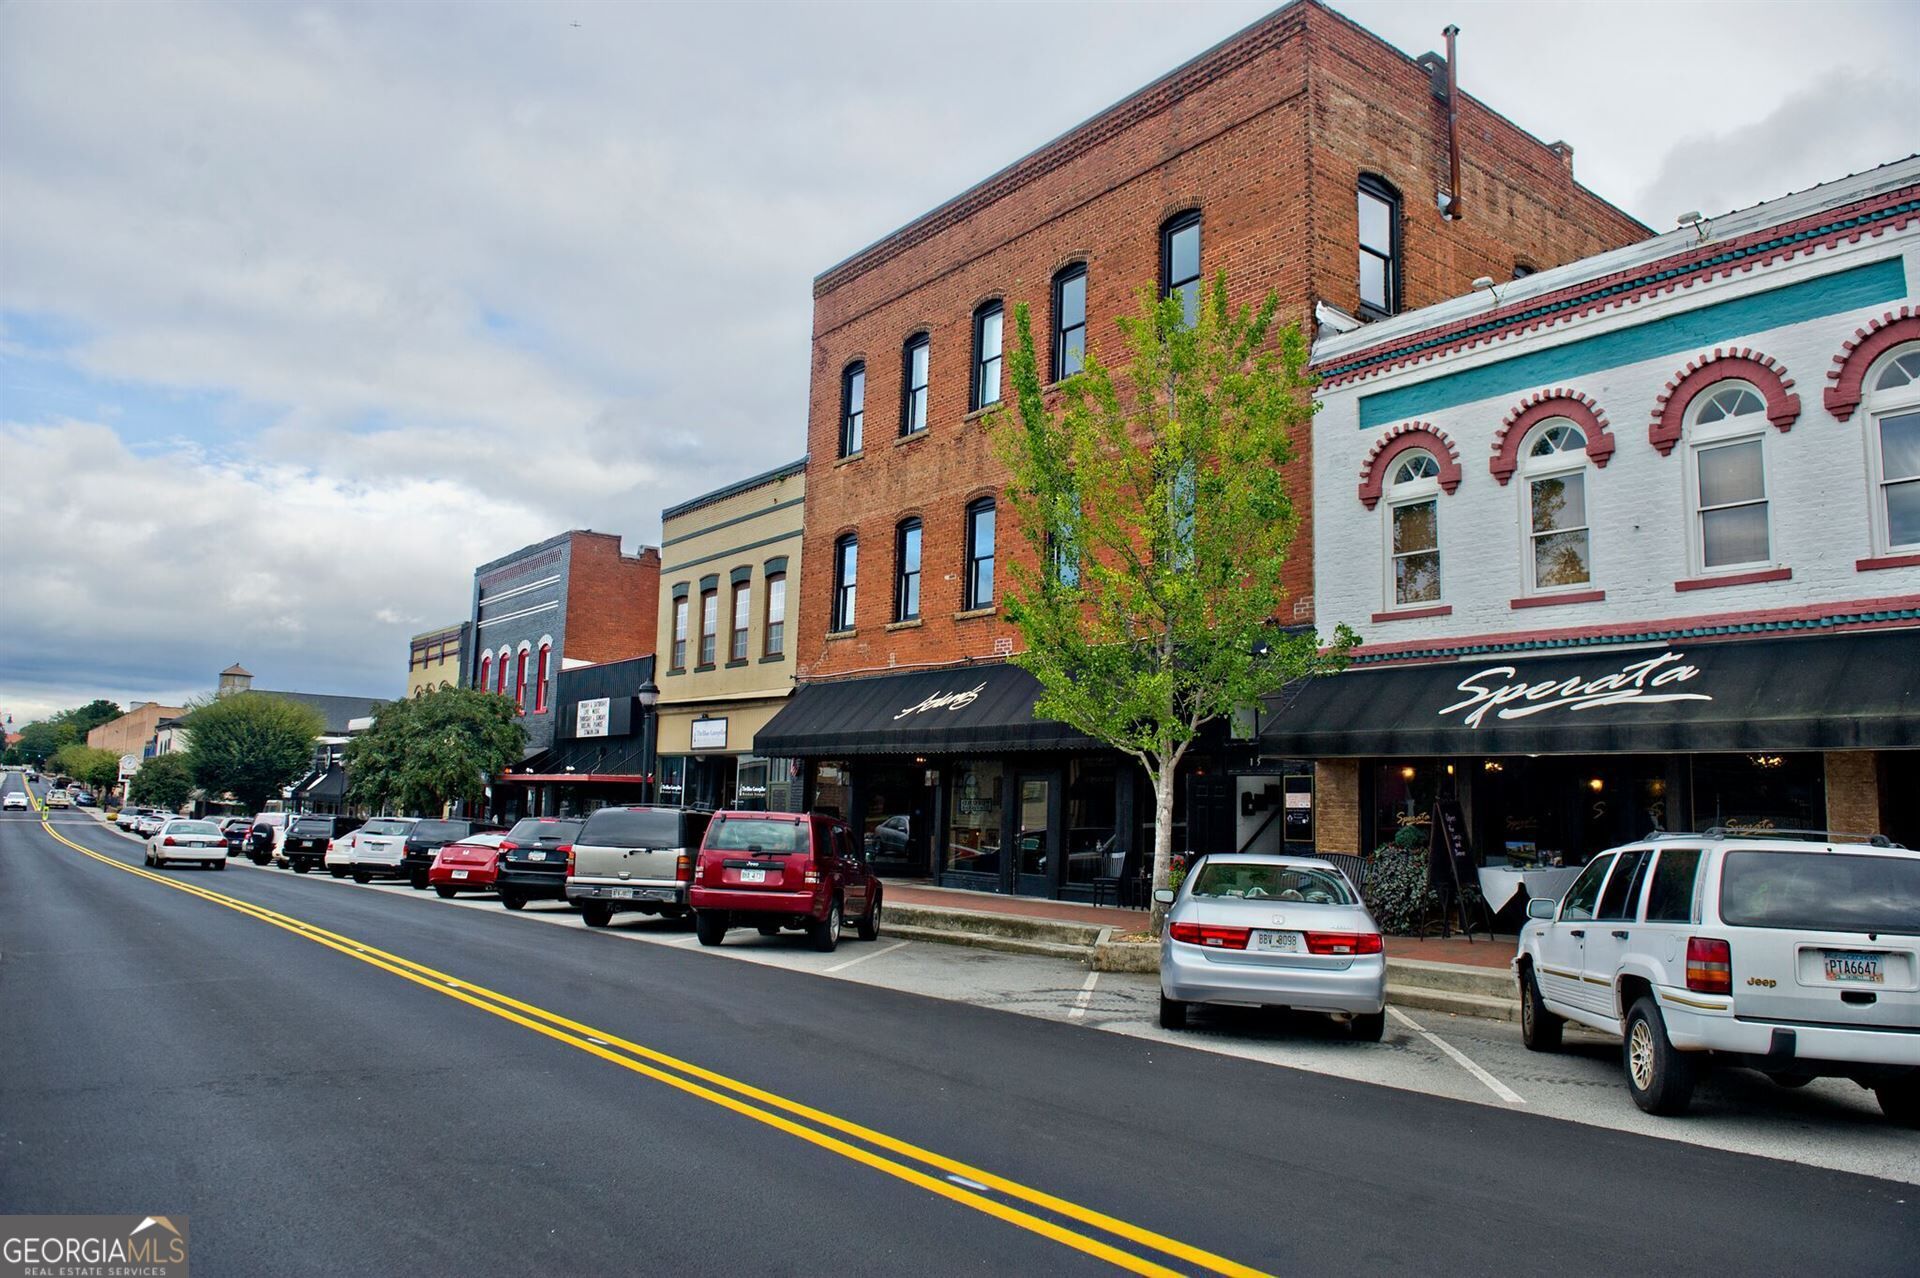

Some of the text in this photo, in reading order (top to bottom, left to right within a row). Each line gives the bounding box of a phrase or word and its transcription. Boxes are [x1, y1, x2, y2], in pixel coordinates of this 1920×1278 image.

[1438, 652, 1712, 729] Sperata
[1396, 811, 1433, 827] Sperata
[1829, 959, 1877, 976] PTA6647
[1747, 976, 1777, 988] Jeep
